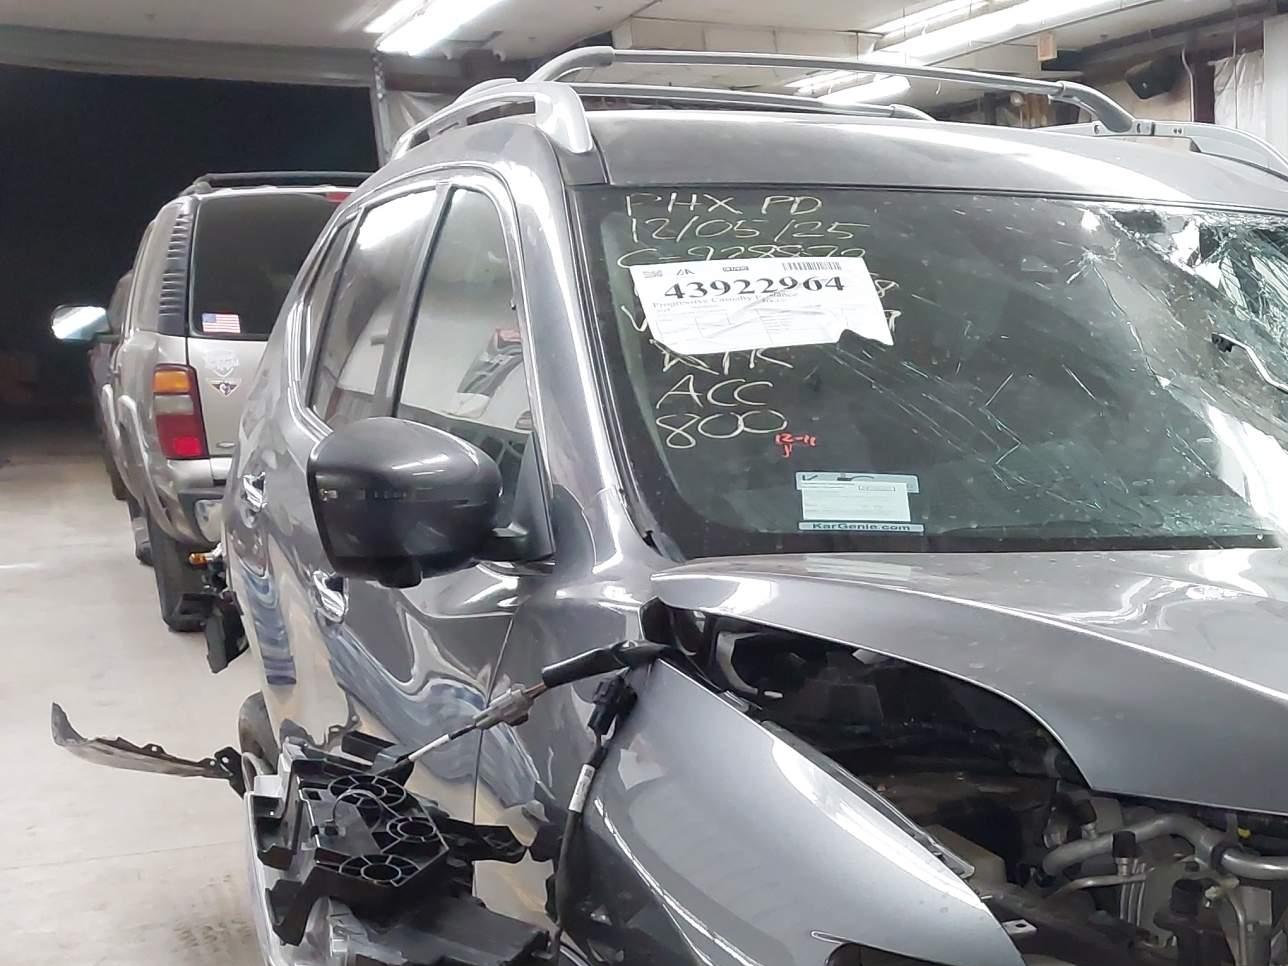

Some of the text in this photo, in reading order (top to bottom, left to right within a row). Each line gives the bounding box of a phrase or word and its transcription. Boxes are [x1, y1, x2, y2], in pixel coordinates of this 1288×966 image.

[626, 192, 823, 216] PHX PD
[631, 216, 870, 243] 12/05/25
[663, 276, 845, 299] 43922964
[656, 374, 774, 409] ACC
[656, 409, 788, 449] 800
